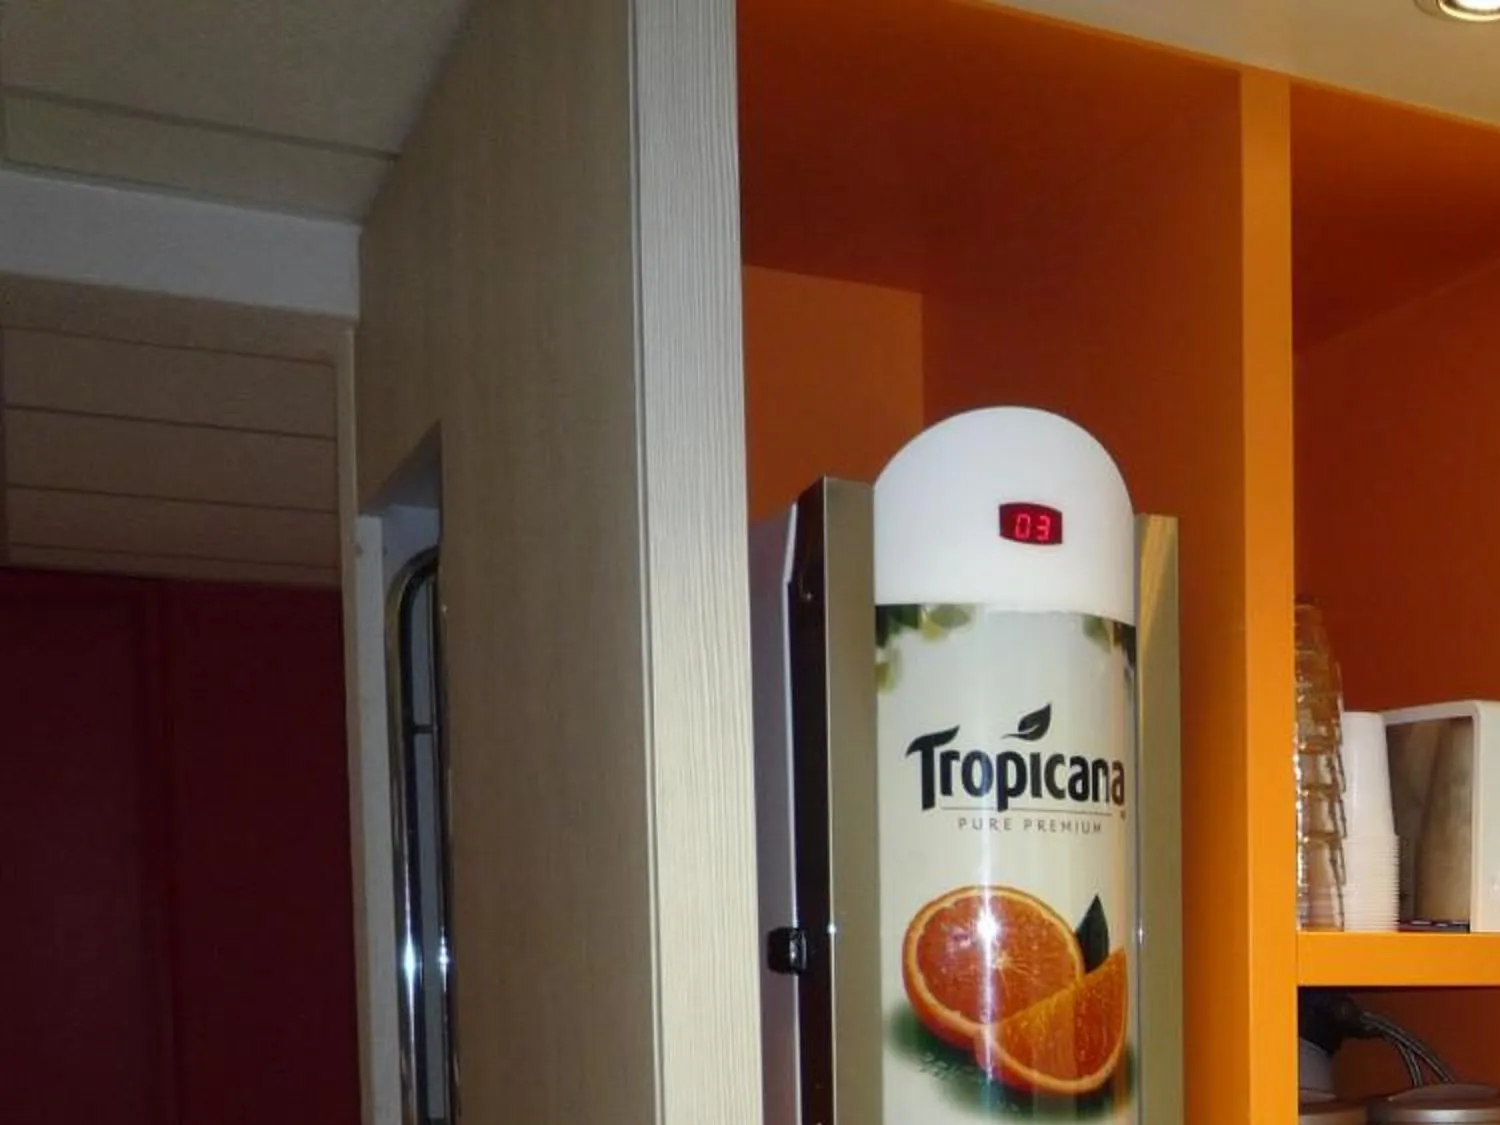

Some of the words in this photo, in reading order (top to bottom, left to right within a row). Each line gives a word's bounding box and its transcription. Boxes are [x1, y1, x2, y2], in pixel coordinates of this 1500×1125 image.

[1014, 512, 1050, 542] 03
[905, 724, 1126, 813] Tropicana
[957, 816, 1013, 832] PURE
[1023, 818, 1103, 835] PREMIUM
